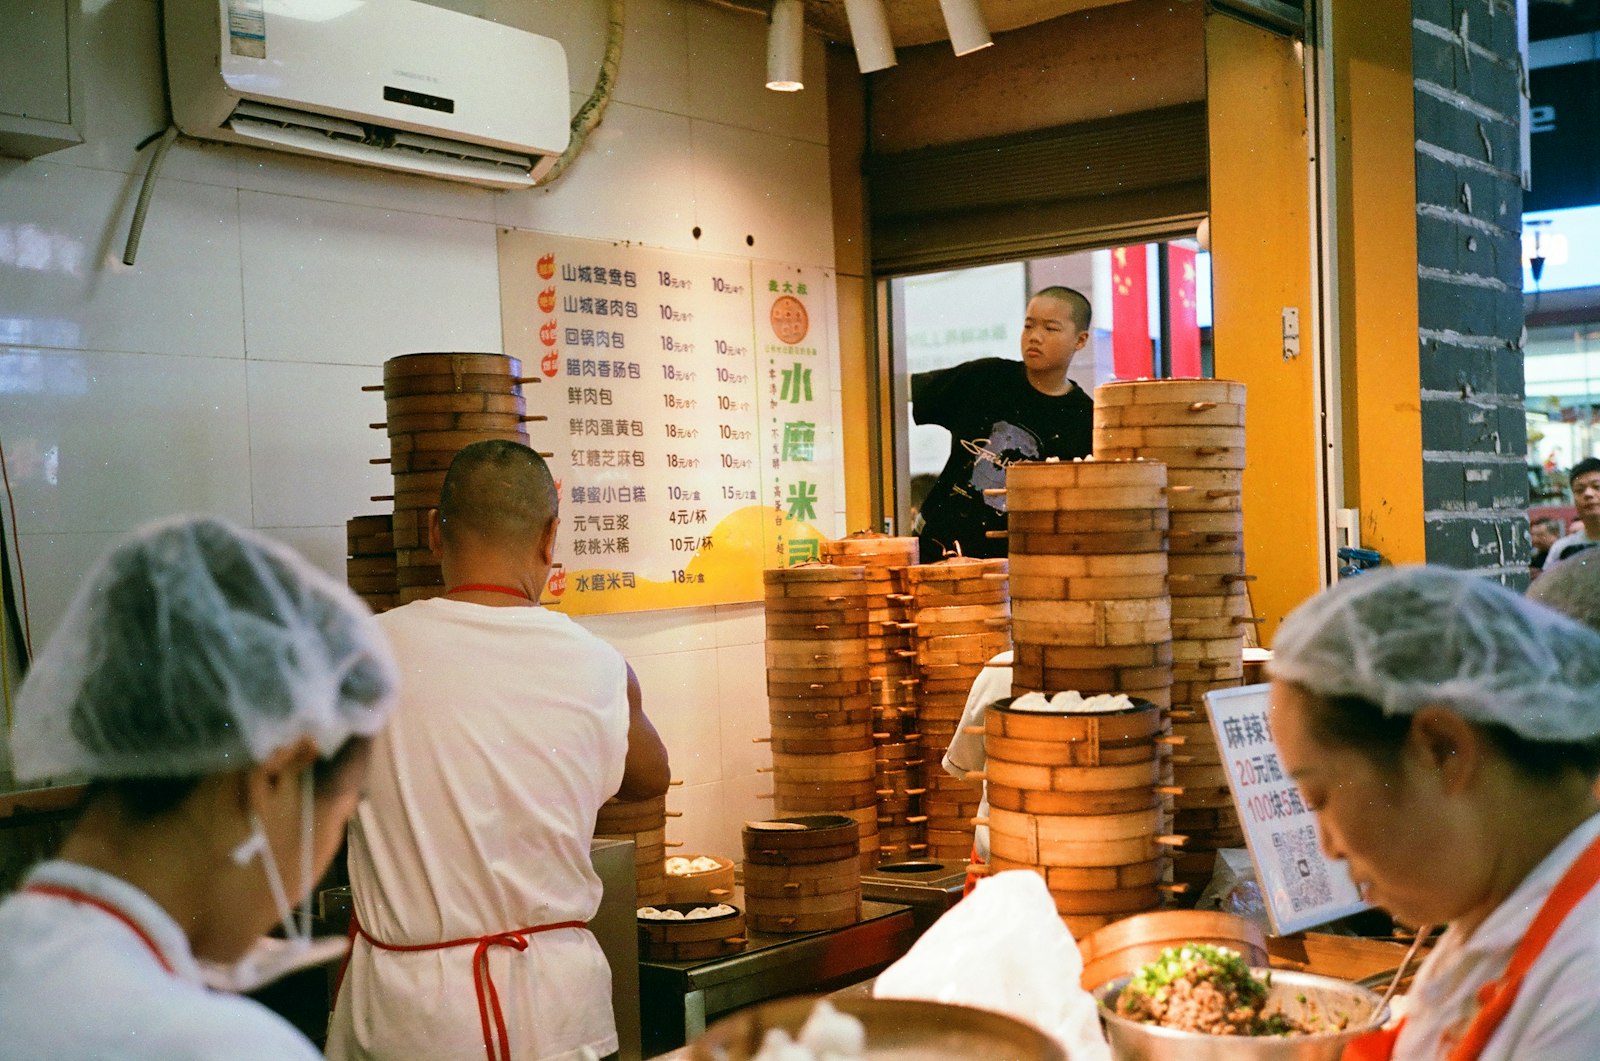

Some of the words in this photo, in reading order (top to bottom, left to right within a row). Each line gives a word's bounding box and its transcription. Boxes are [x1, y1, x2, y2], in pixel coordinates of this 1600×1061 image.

[562, 263, 637, 288] 山城鸳鸯包
[564, 295, 638, 318] 山城酱肉包
[565, 328, 625, 349] 回锅肉包
[566, 358, 641, 379] 腊肉香肠包
[568, 386, 613, 406] 鲜肉包
[569, 418, 644, 437] 鲜肉蛋黄包
[665, 424, 699, 440] 18元/6个
[719, 424, 752, 440] 10元/3个
[571, 449, 646, 468] 红糖芝麻包
[666, 453, 701, 469] 18元/8个
[720, 453, 753, 470] 10元/4个
[571, 485, 647, 505] 蜂蜜小白糕
[668, 486, 701, 501] 10元/盒
[573, 514, 630, 533] 元气豆浆
[669, 509, 708, 526] 4元/杯
[573, 536, 630, 556] 核桃米稀
[670, 535, 714, 552] 10元/杯
[575, 571, 637, 593] 水磨米司
[671, 569, 705, 584] 18元/盒
